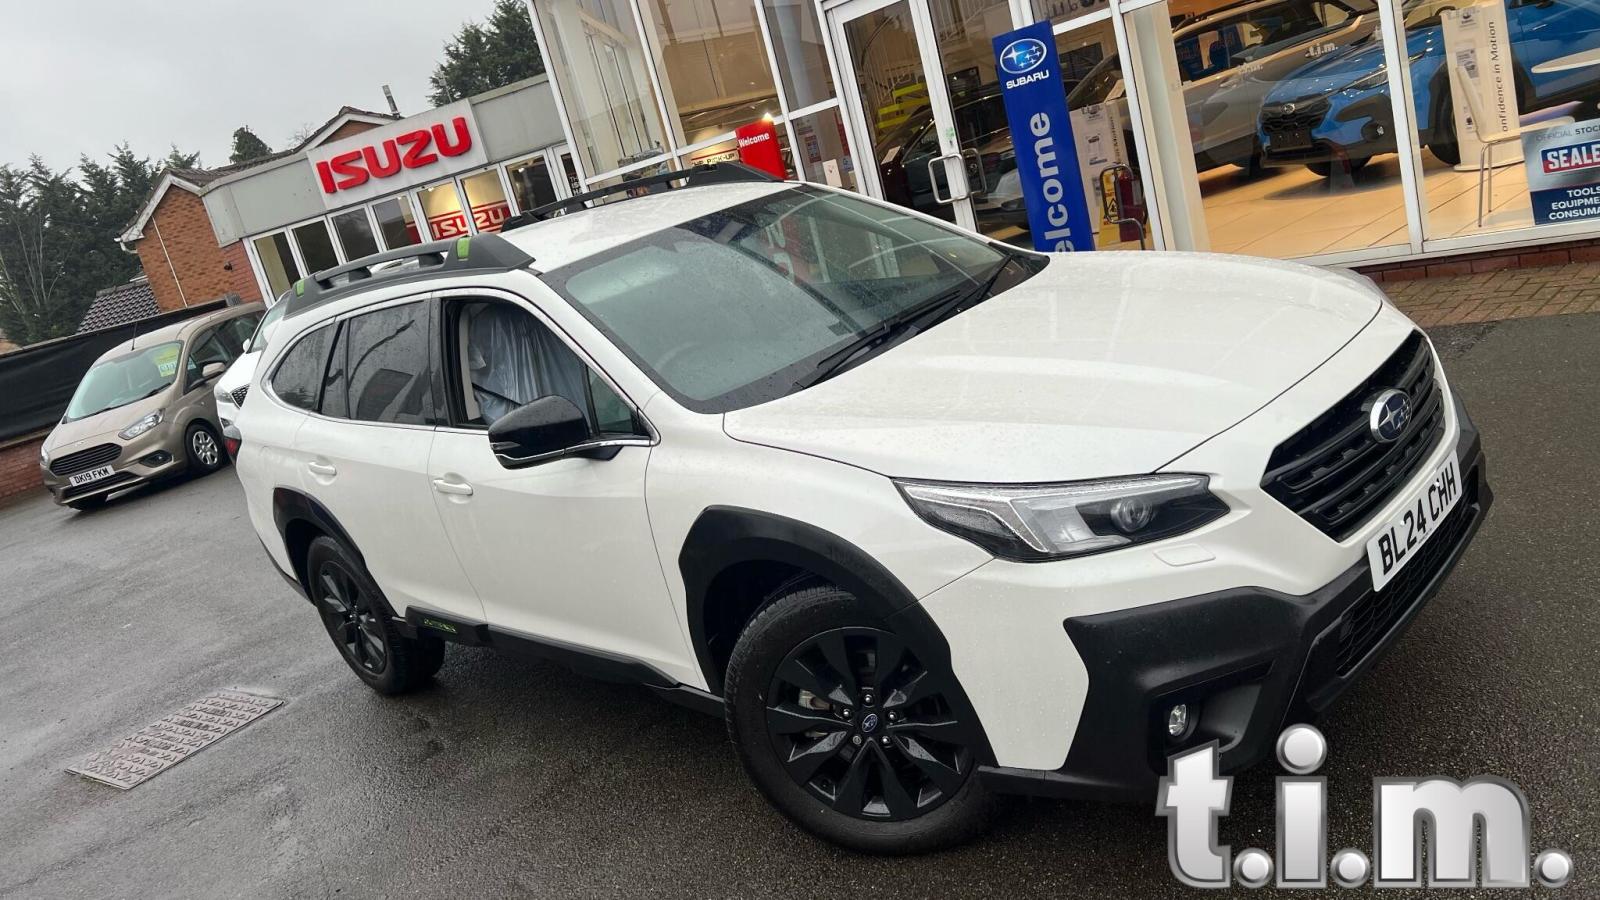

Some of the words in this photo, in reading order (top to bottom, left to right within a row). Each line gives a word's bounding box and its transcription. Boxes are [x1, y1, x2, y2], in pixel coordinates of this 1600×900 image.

[1488, 21, 1499, 61] Motion
[1493, 63, 1501, 74] in
[1006, 69, 1049, 89] SUBARU
[738, 132, 769, 148] Welcome
[316, 116, 472, 194] ISUZU
[74, 471, 92, 484] DK19
[92, 467, 110, 480] FKM
[1378, 498, 1427, 576] BL24
[1428, 462, 1457, 522] CHH
